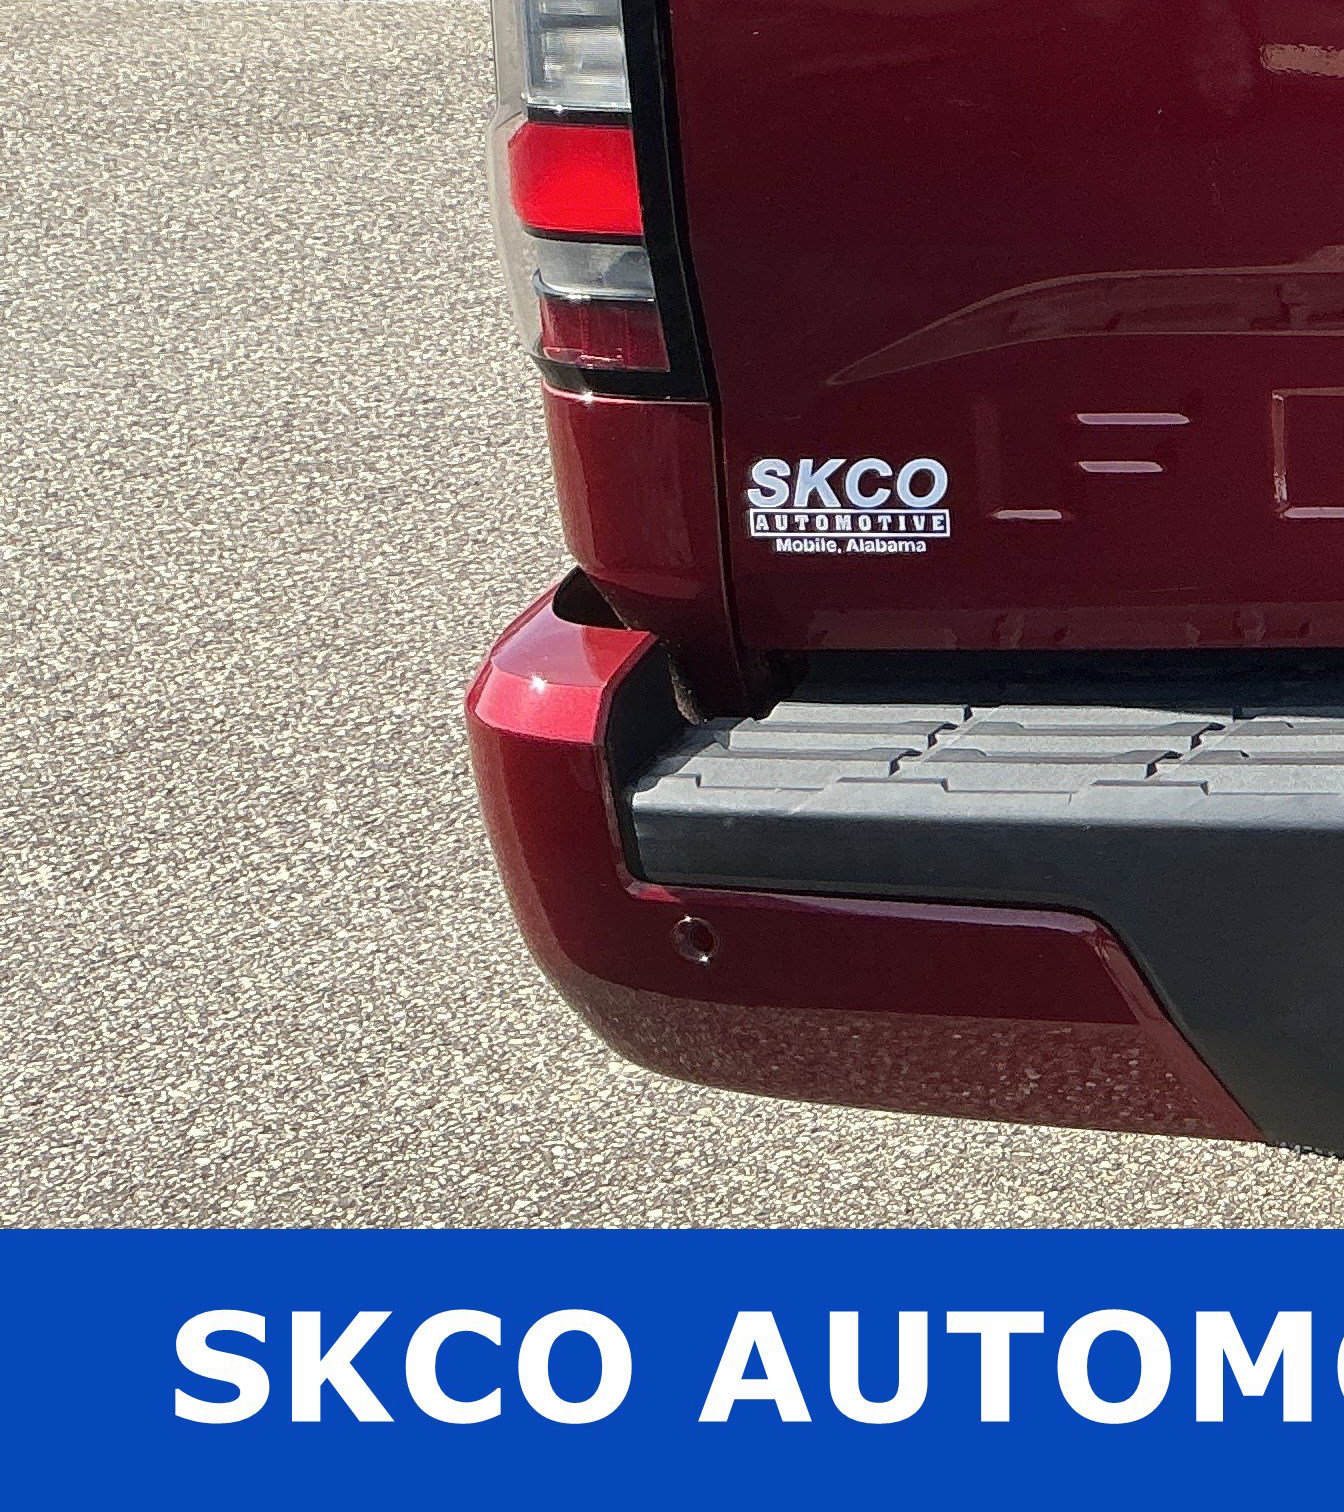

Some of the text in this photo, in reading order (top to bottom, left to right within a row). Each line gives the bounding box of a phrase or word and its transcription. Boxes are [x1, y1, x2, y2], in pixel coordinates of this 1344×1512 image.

[747, 457, 949, 508] SKCO
[755, 514, 946, 531] AUTOMOTIVE
[776, 538, 927, 554] Mobile, Alabama
